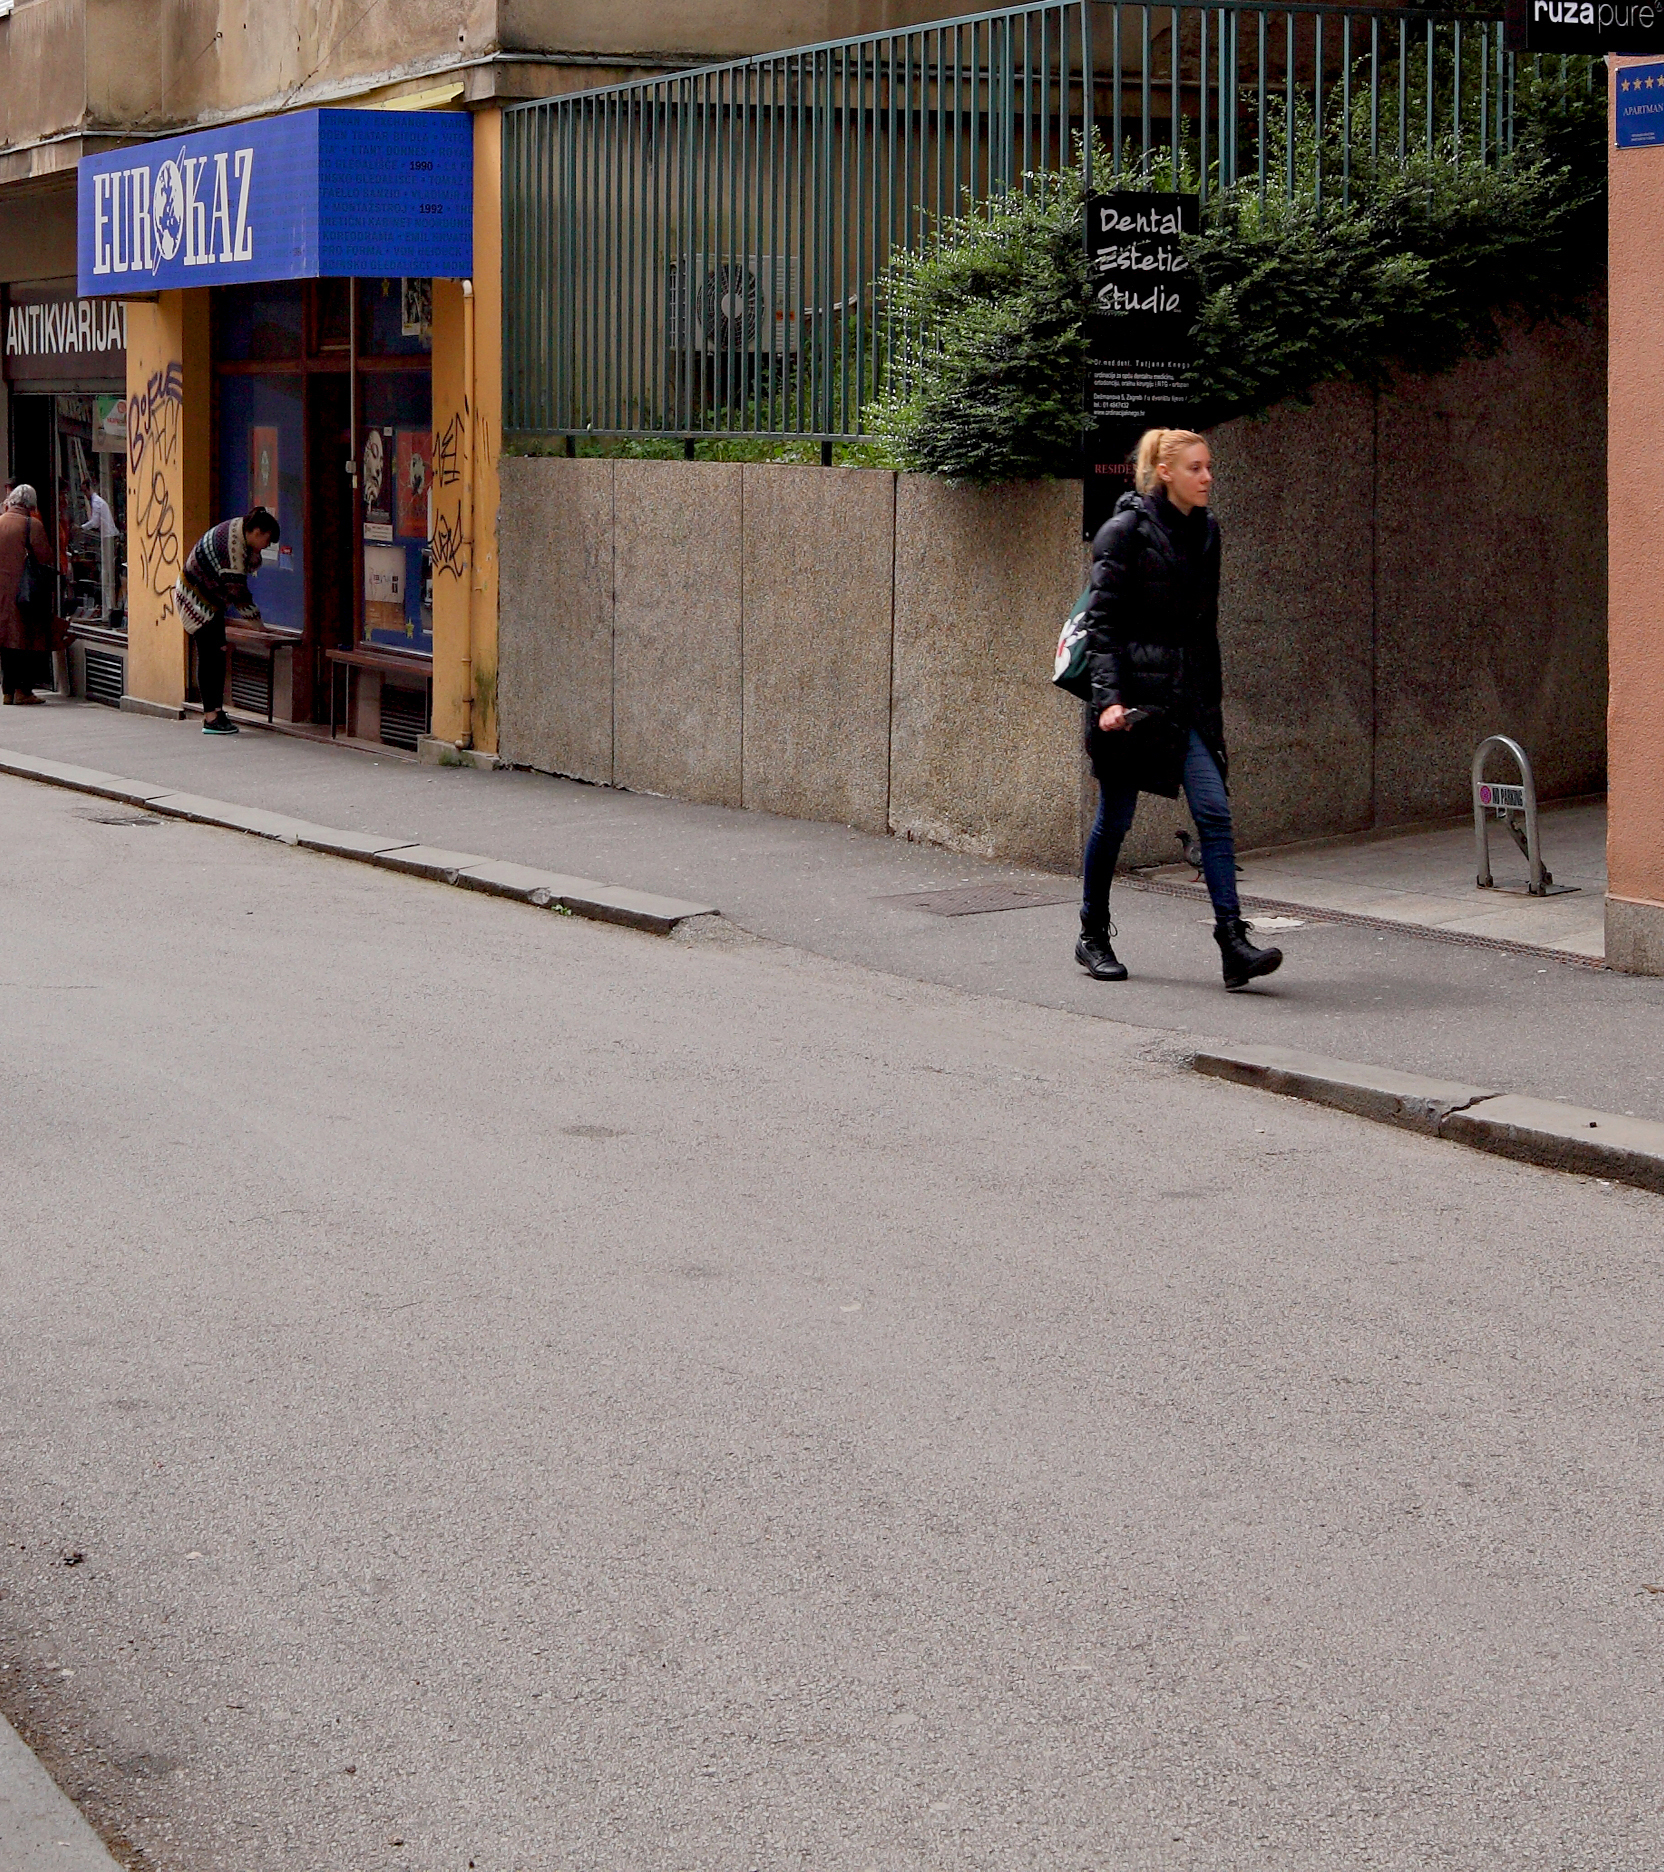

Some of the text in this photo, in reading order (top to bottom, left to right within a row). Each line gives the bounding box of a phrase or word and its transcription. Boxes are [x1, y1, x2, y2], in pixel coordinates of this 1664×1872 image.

[1623, 103, 1664, 116] APARTMAN
[410, 161, 433, 171] 1990
[420, 203, 443, 214] 1992
[1100, 206, 1182, 234] Dental
[1097, 244, 1190, 272] Estetic
[1098, 283, 1180, 313] Studio
[6, 300, 127, 356] ANTIKVARIJAT
